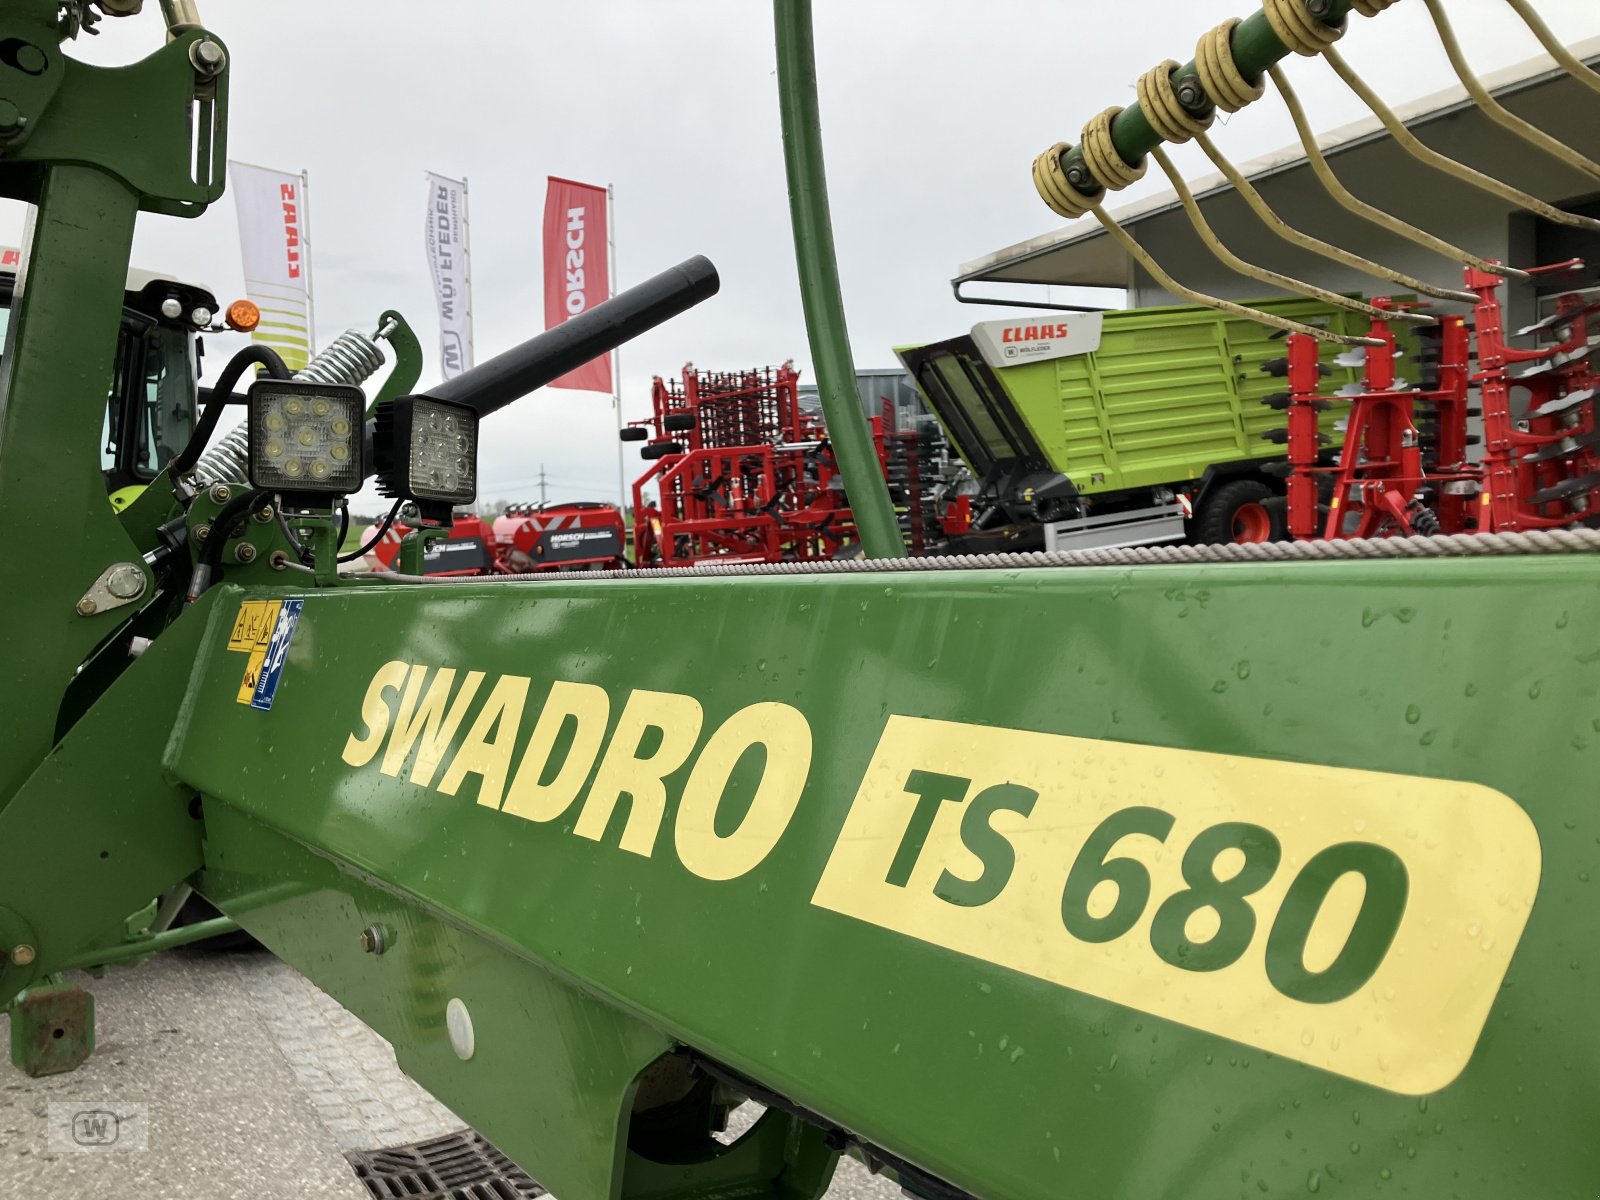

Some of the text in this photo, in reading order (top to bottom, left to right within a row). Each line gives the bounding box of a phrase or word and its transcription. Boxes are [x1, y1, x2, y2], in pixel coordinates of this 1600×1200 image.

[1002, 323, 1068, 343] CLAAS
[550, 532, 585, 542] HORSCH
[341, 660, 812, 881] SWADRO
[885, 769, 1409, 1004] TS 680
